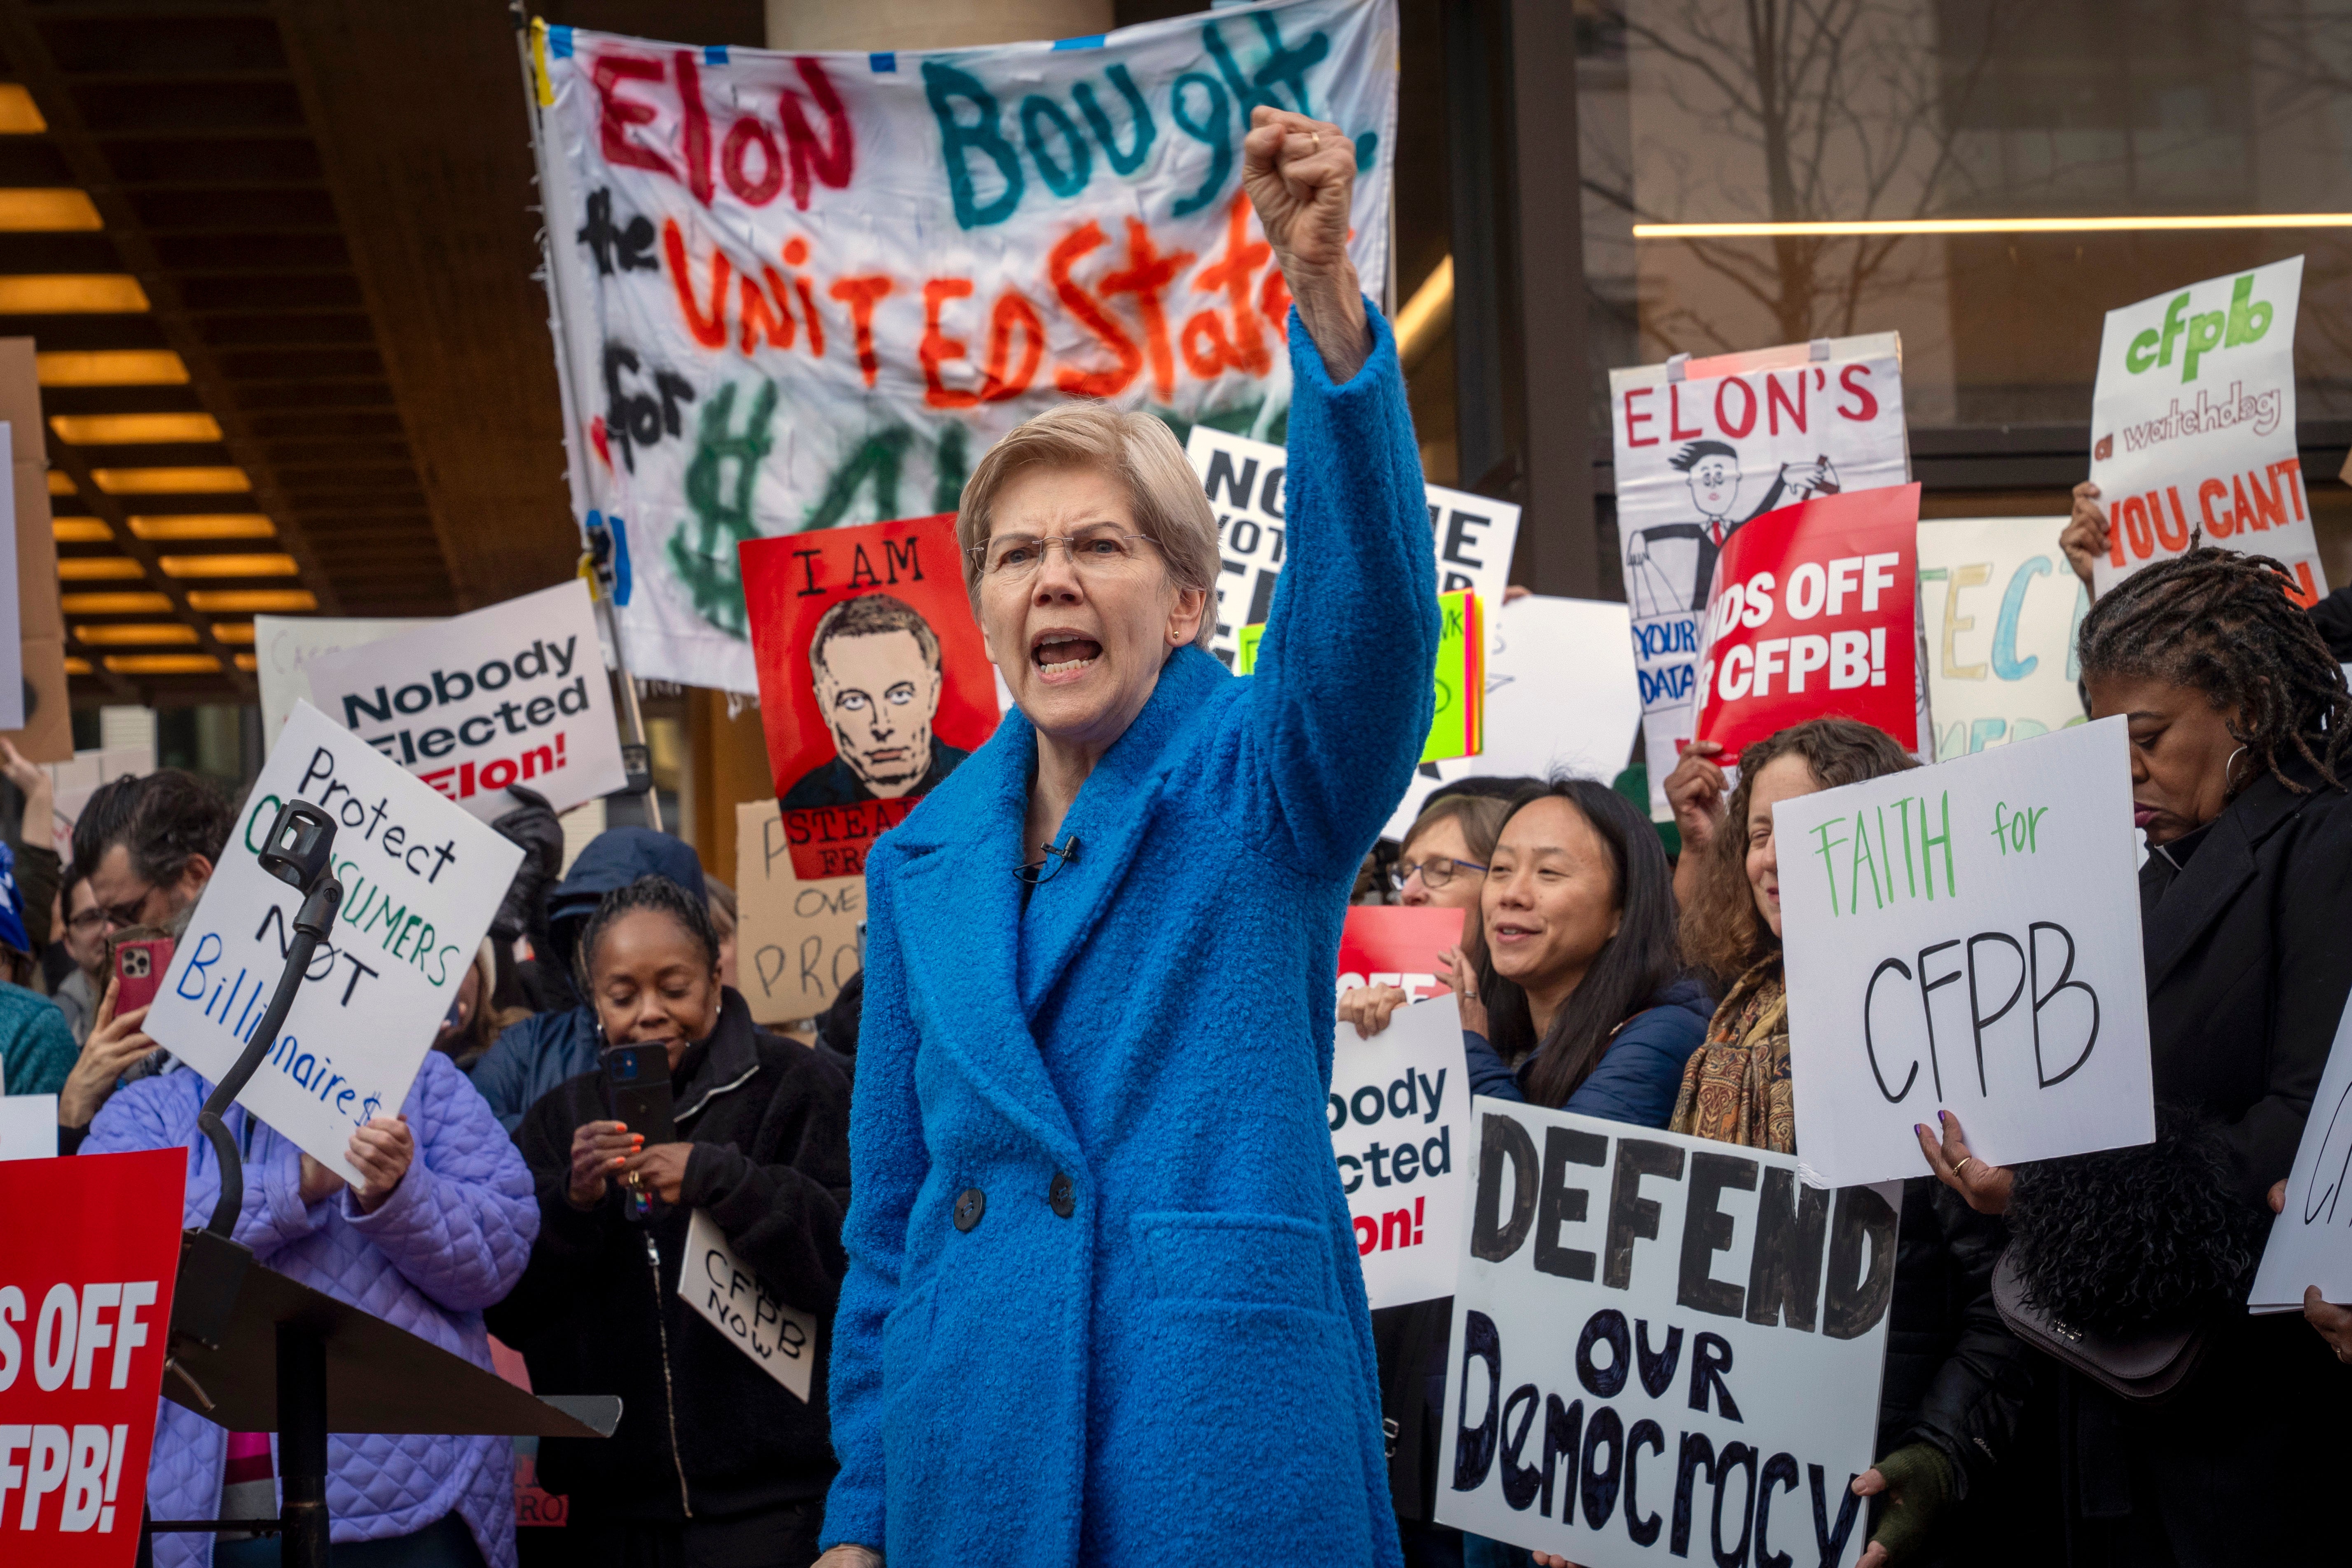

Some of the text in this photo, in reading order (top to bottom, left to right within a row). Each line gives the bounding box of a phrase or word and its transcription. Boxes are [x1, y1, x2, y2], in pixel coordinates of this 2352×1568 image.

[2125, 274, 2274, 384] cfpb
[604, 343, 696, 475] for
[1624, 363, 1879, 448] ELON'S
[2094, 380, 2281, 461] a watchdog
[2106, 457, 2307, 568] YOU CAN'T
[793, 537, 924, 597] I AM
[1786, 552, 1899, 620] OFF
[342, 635, 578, 729] Nobody
[1632, 618, 1697, 661] YOUR
[1638, 663, 1694, 704] DATA
[1718, 627, 1886, 701] CFPB!
[367, 678, 589, 765] Elected
[417, 732, 567, 802] Elon!
[297, 747, 457, 885] Protect
[1809, 790, 2048, 917] FAITH for
[245, 794, 459, 987] CSUMERS
[1864, 921, 2100, 1104] CFPB
[1470, 1112, 1898, 1340] DEFEND
[33, 1280, 159, 1392] OFF
[705, 1250, 805, 1359] CFPB
[707, 1289, 773, 1359] NOW
[1576, 1308, 1744, 1423] OUR
